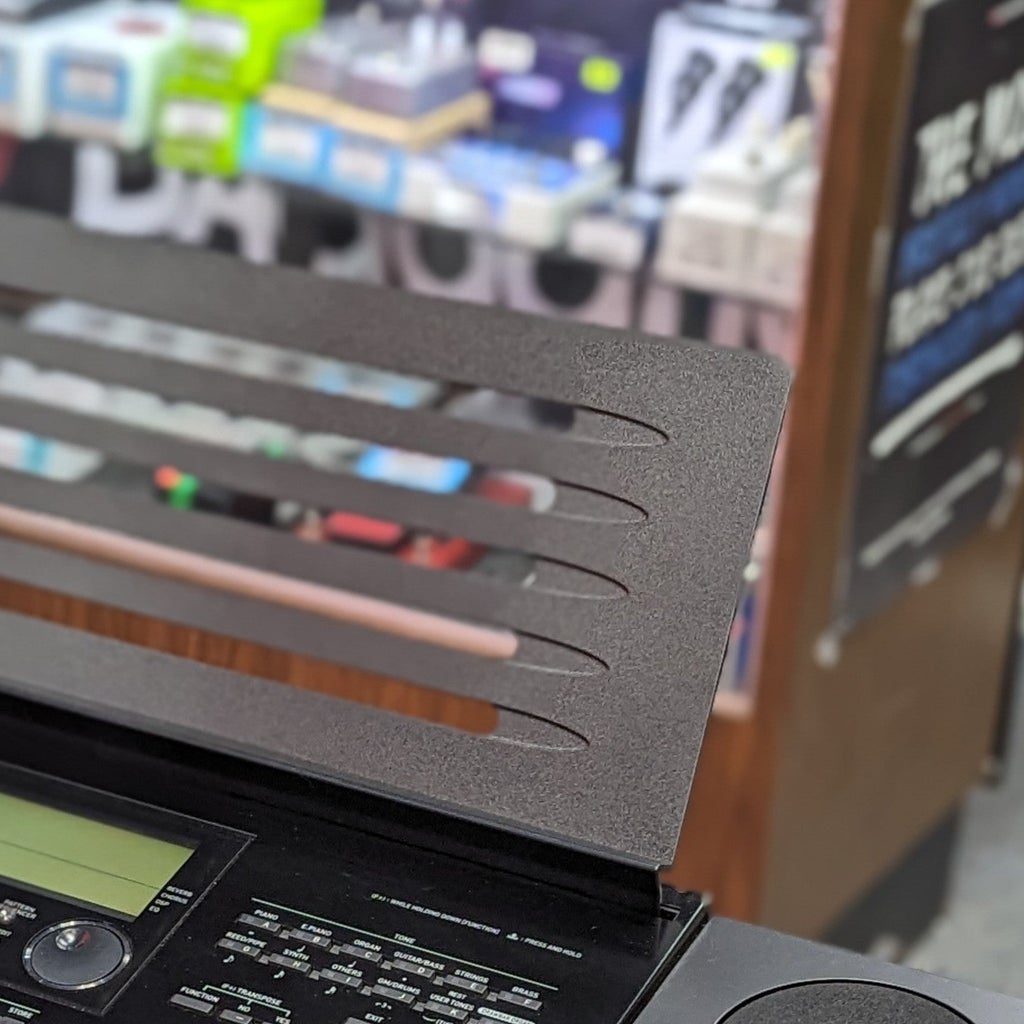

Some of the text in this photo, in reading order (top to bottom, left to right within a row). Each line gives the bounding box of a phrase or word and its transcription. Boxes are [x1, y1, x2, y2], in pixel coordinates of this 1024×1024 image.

[254, 909, 279, 921] PIANO
[300, 923, 333, 937] E.PIANO
[225, 931, 267, 949] REED/PIPE
[353, 939, 382, 952] ORGAN
[394, 933, 416, 945] TONE
[283, 949, 310, 961] SYNTH
[524, 937, 583, 959] PRESS AND HOLD
[393, 951, 445, 970] GUITAR/BASS
[331, 963, 363, 978] OTHERS
[454, 969, 490, 984] STRINGS
[377, 977, 421, 995] GM/DRUMS
[511, 986, 540, 999] BRASS
[180, 986, 220, 1003] FUNCTION
[237, 987, 283, 1006] TRANSPOSE
[237, 1004, 251, 1013] NO
[430, 993, 475, 1011] USER TONES
[8, 1007, 34, 1019] STORE
[364, 1013, 384, 1024] EXIT
